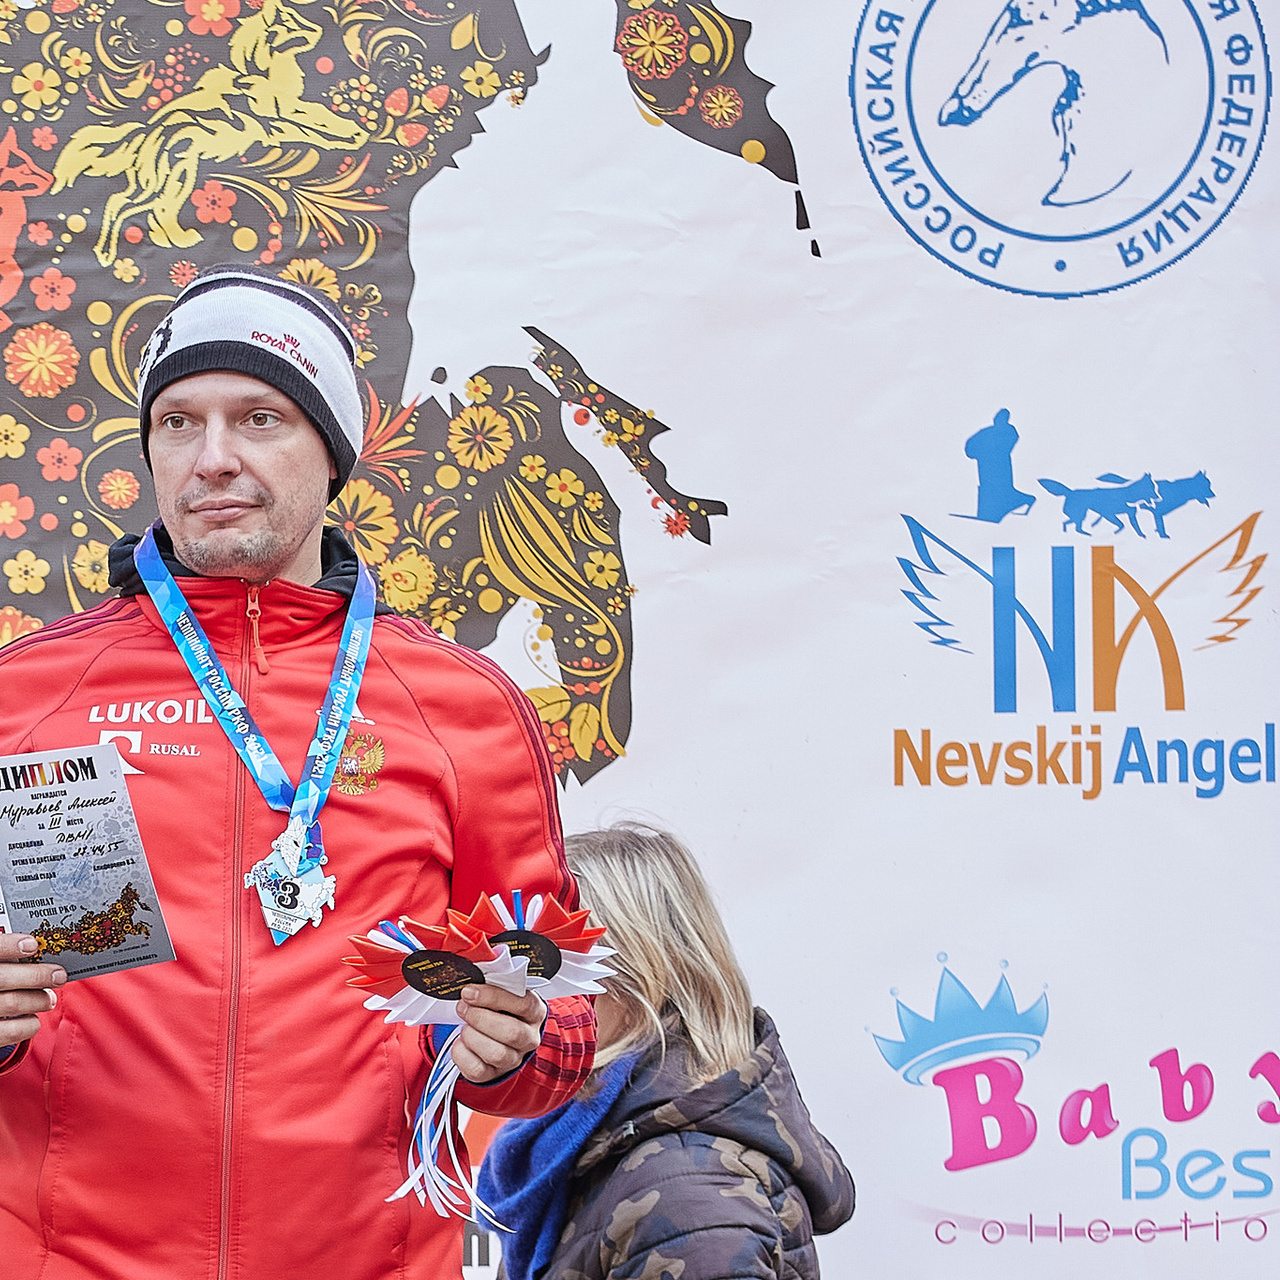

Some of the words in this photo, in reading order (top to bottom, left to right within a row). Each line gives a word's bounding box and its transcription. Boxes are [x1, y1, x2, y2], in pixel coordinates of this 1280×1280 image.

[866, 10, 1005, 268] РОССИЙСКАЯ
[1117, 33, 1256, 268] ФЕДЕРАЦИЯ
[251, 330, 287, 353] ROYAL
[289, 348, 318, 379] CANIN
[176, 611, 214, 669] ЧЕМПИОНАТ
[205, 668, 236, 710] РОССИИ
[228, 708, 250, 734] РКФ
[339, 629, 363, 689] ЧЕМПИОНАТ
[88, 699, 214, 724] LUKOIL
[327, 687, 348, 727] РОССИИ
[148, 743, 200, 756] RUSAL
[319, 726, 337, 753] РКФ
[310, 752, 330, 780] 2021
[893, 724, 1103, 800] Nevskij
[1113, 722, 1276, 799] Angel
[10, 897, 54, 910] ЧЕМПИОНАТ
[28, 907, 58, 918] РОССИИ
[59, 904, 77, 914] РКФ
[277, 881, 300, 909] 3
[934, 1212, 1268, 1245] collectio
